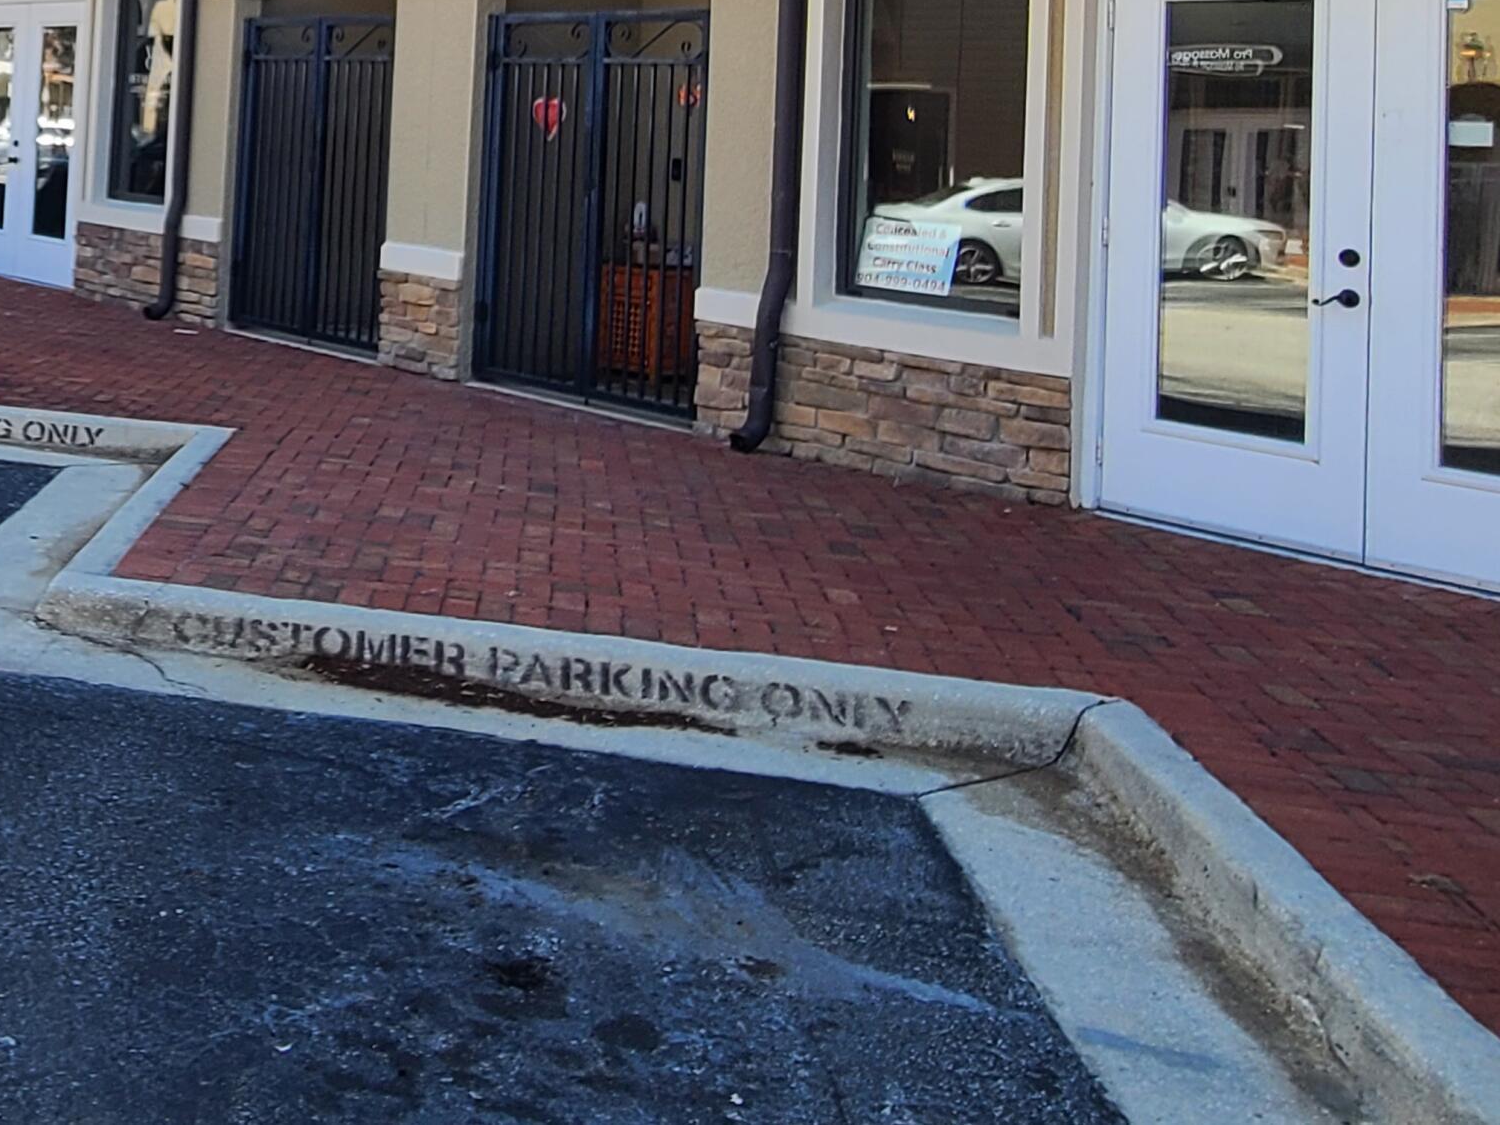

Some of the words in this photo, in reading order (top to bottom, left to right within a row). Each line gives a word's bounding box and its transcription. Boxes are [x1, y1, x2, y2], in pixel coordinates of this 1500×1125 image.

[872, 256, 904, 273] Carry
[905, 259, 937, 274] Class
[21, 419, 105, 448] ONLY
[173, 612, 466, 677] CUSTOMER
[487, 646, 737, 710] PARKING
[760, 681, 914, 733] ONLY
